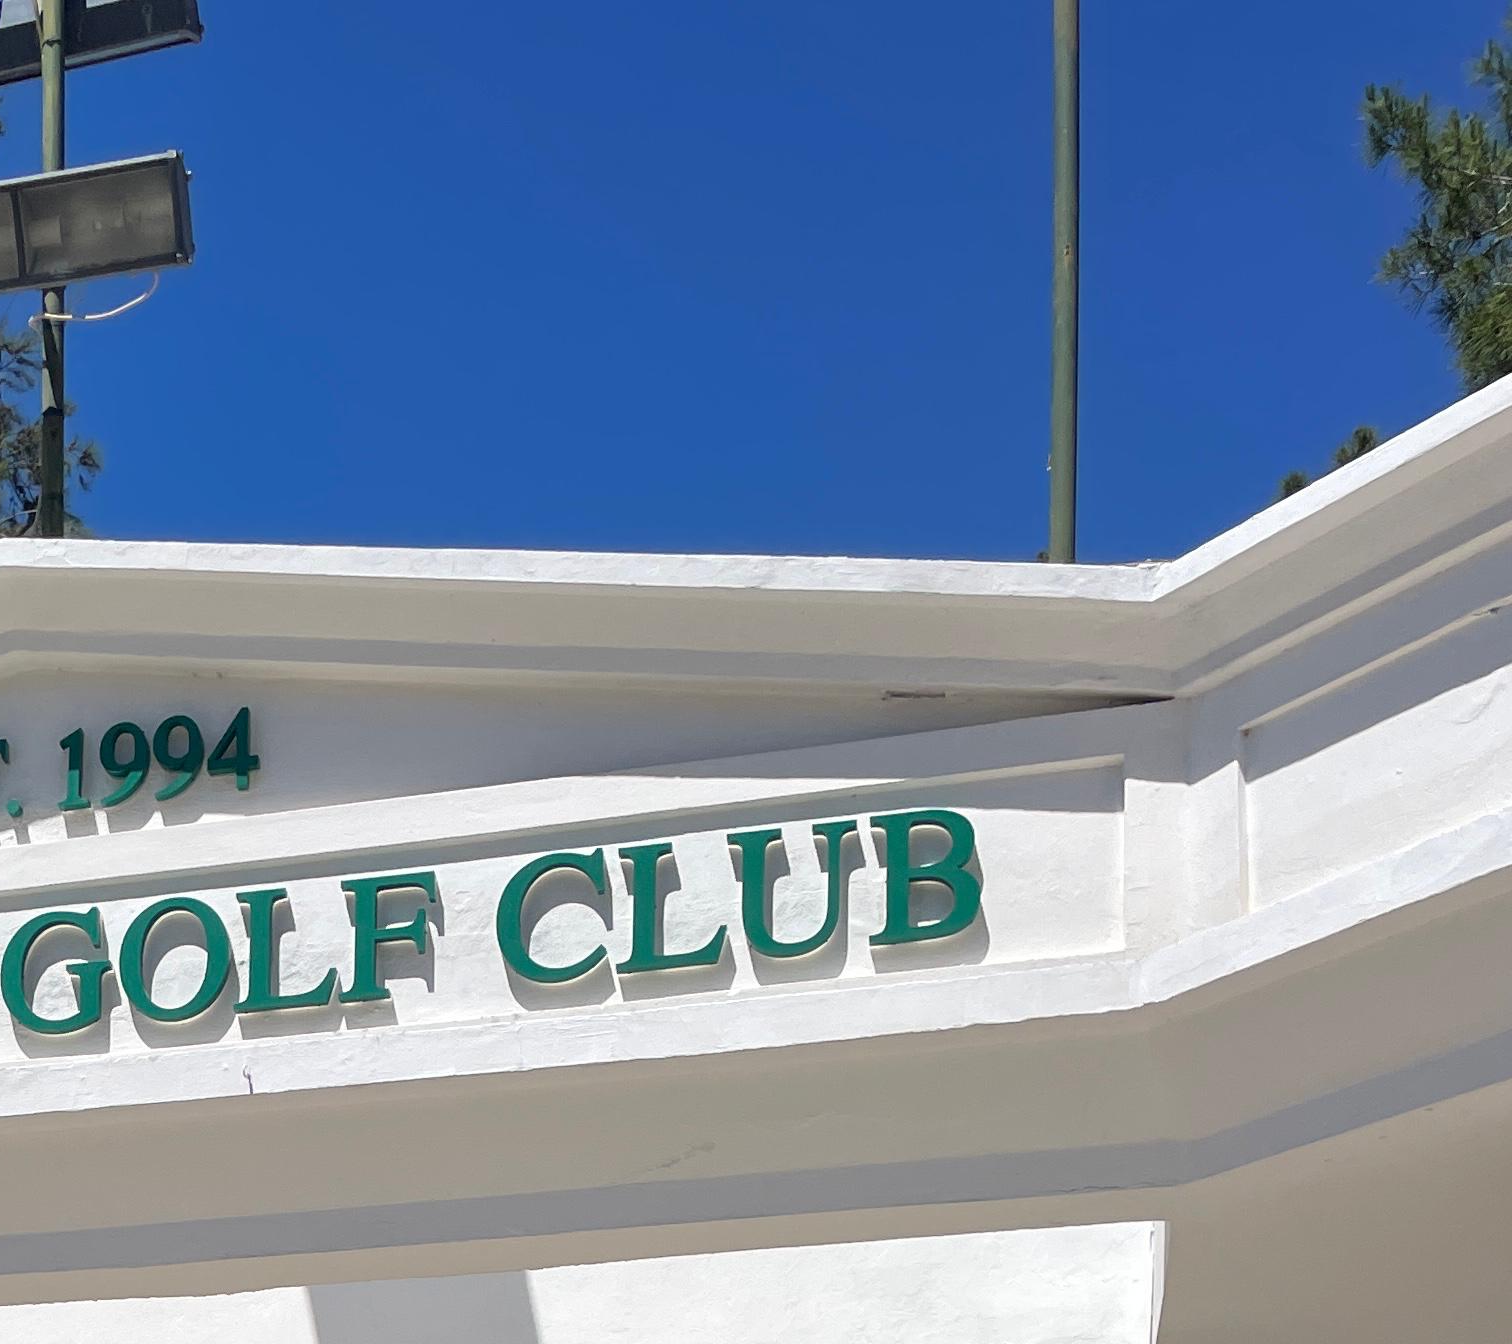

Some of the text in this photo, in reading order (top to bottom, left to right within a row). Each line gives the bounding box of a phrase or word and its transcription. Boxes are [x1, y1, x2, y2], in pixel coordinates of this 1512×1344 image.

[59, 707, 261, 811] 1994
[0, 871, 438, 1034] GOLF
[496, 808, 985, 982] CLUB
